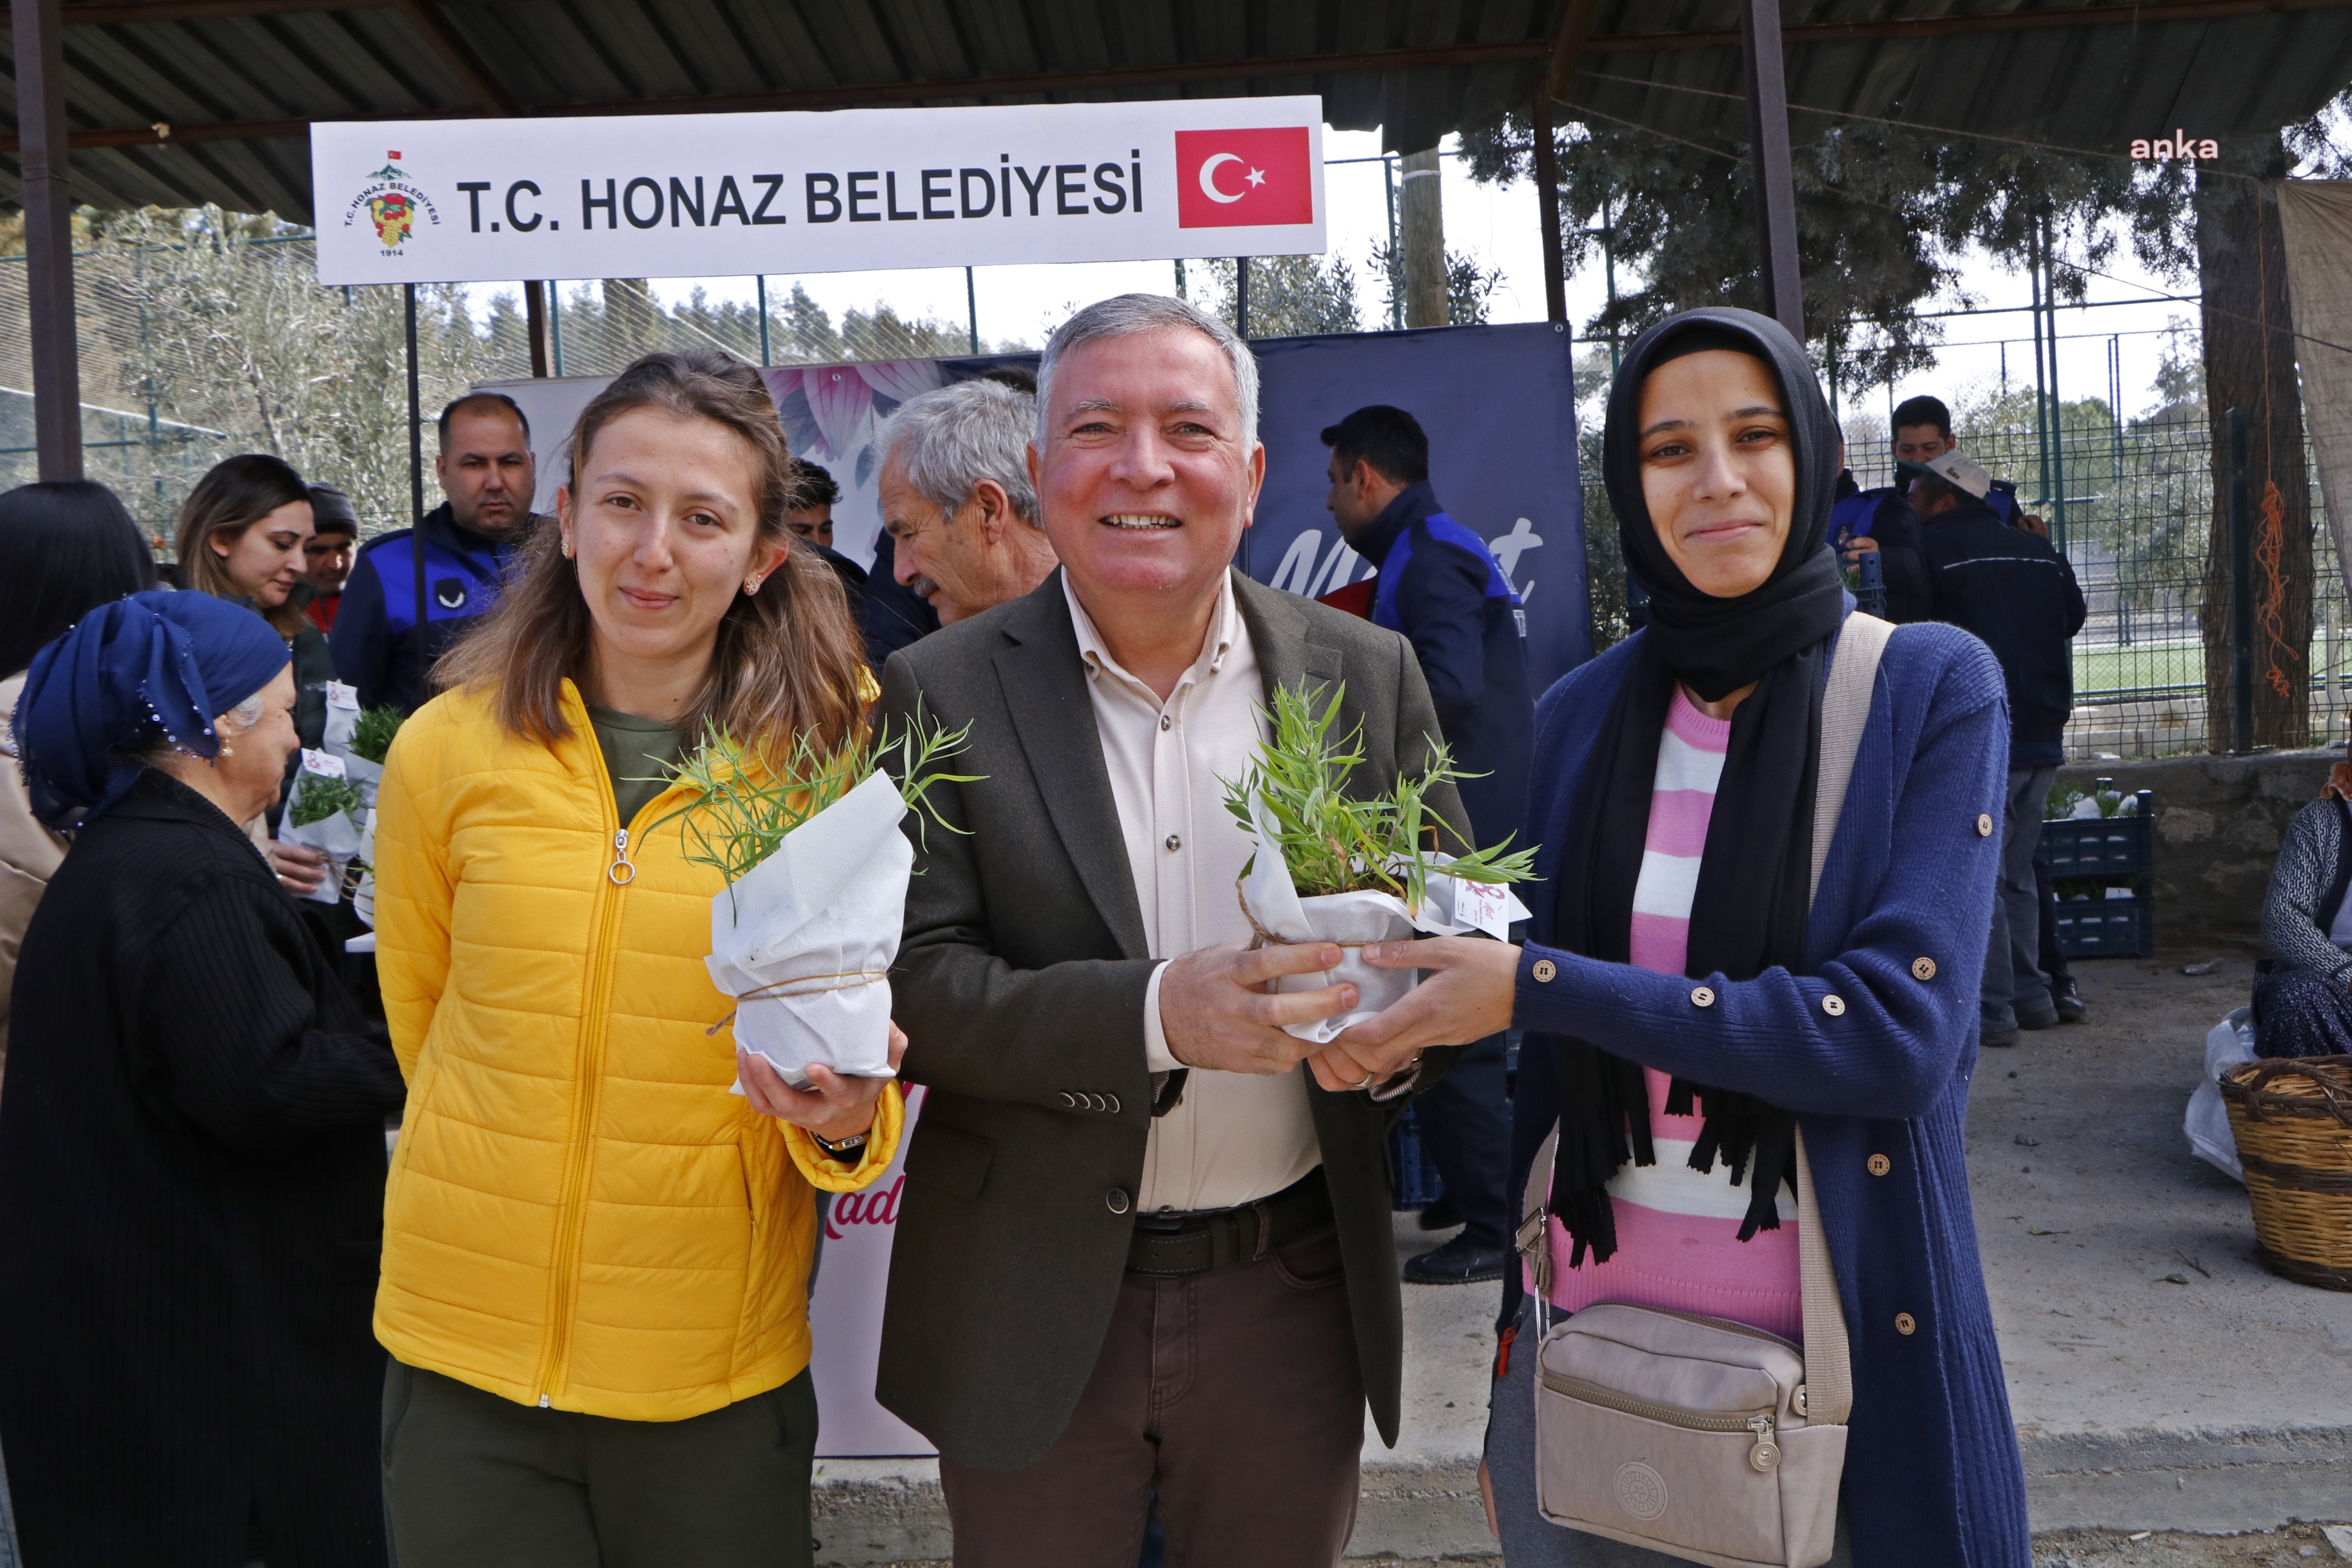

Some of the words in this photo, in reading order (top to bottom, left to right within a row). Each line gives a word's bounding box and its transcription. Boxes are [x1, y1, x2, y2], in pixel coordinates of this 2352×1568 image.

[390, 182, 441, 225] BELEDİYESİ
[457, 178, 559, 233] T.C.
[581, 172, 787, 230] HONAZ
[806, 149, 1143, 224] BELEDİYESİ
